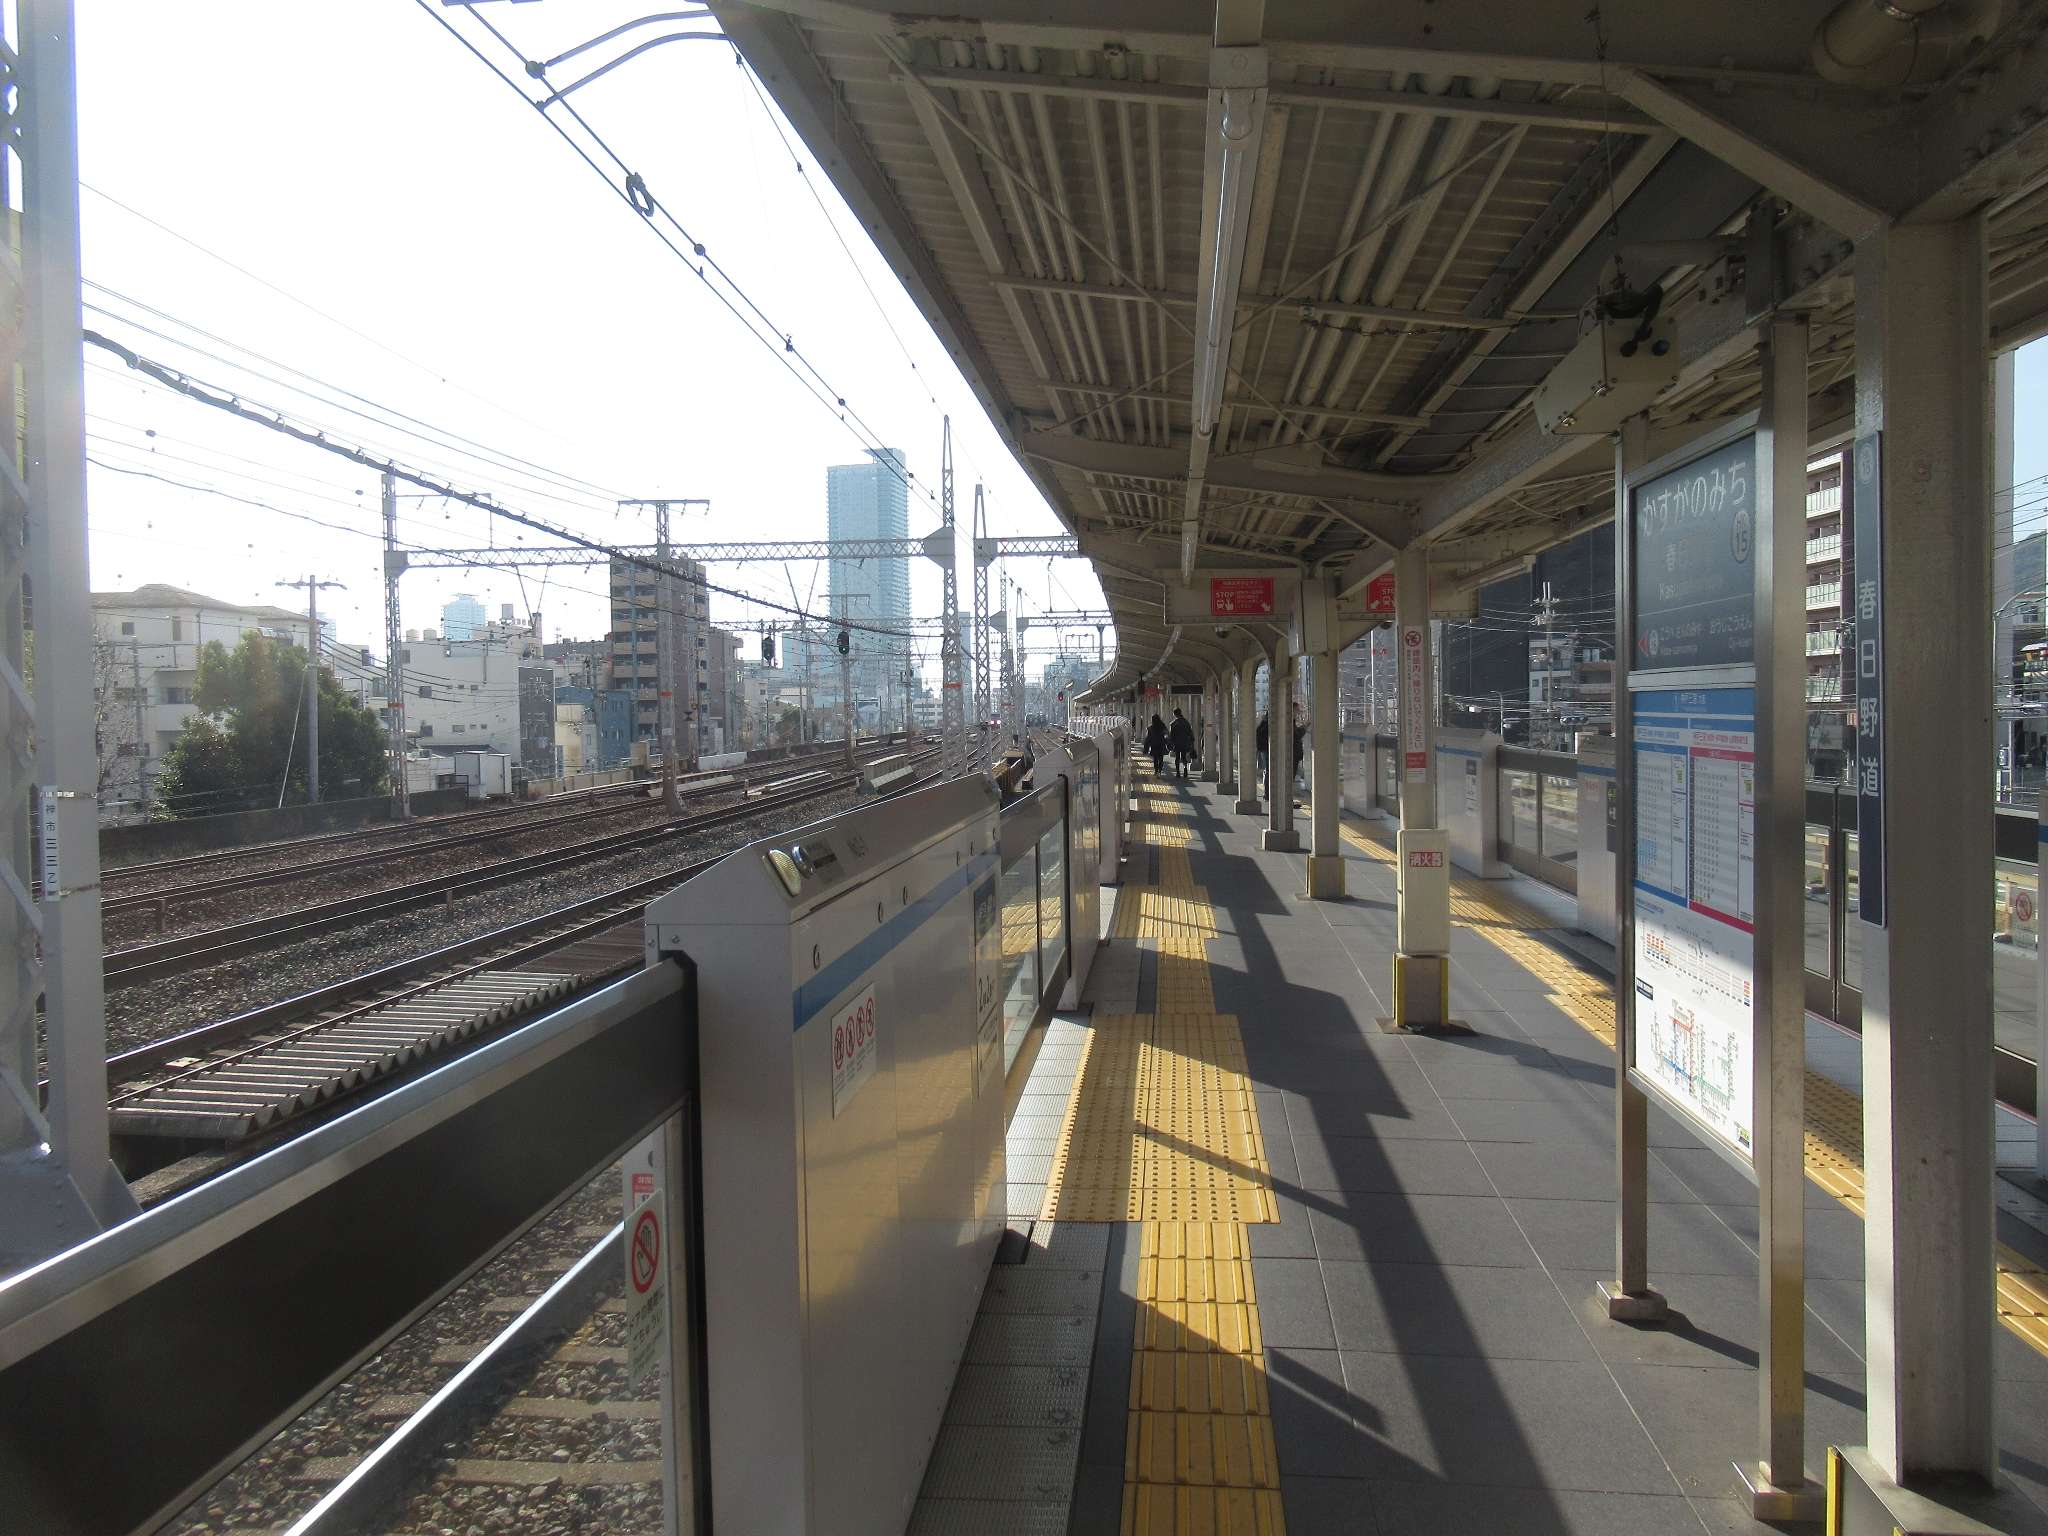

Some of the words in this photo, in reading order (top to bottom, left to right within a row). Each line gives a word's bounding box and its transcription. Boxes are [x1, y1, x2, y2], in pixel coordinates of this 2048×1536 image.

[1643, 461, 1746, 536] かすがのみち
[1858, 579, 1879, 798] 春日野道
